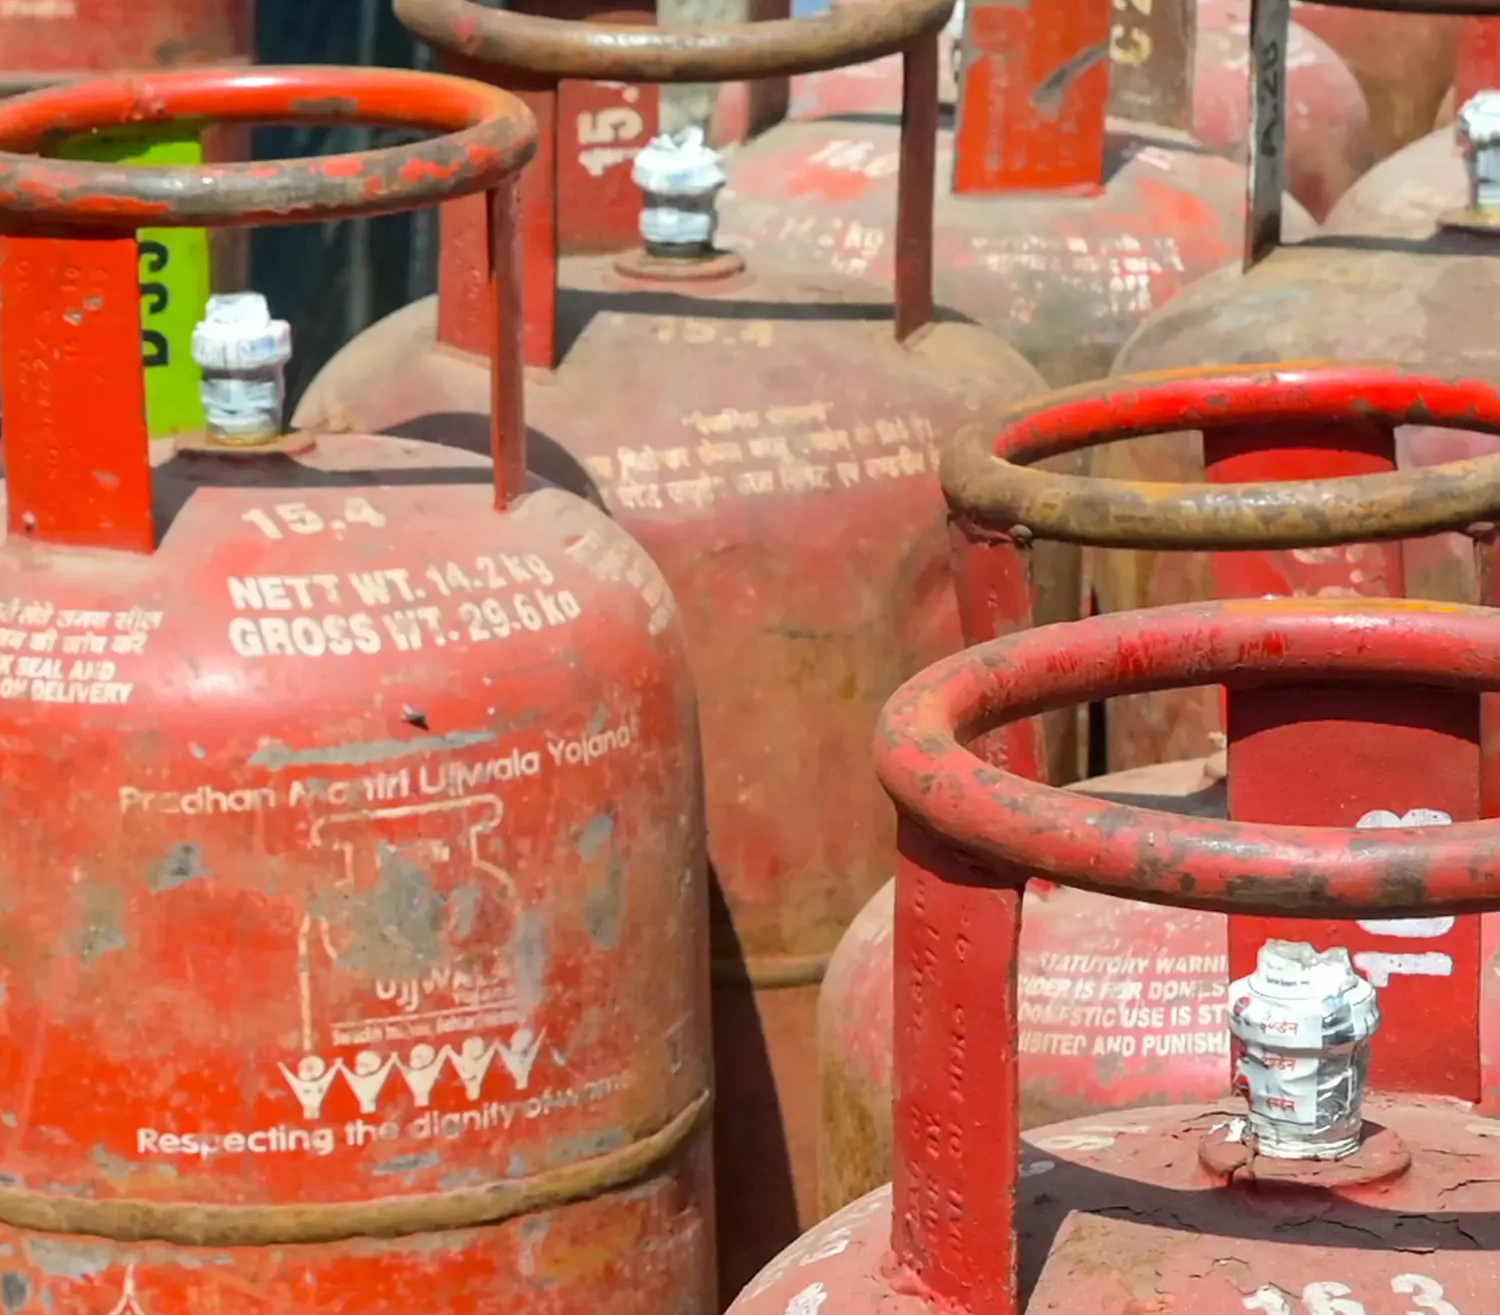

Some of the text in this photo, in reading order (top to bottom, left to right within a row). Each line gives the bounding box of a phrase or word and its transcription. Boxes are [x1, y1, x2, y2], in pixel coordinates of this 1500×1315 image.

[226, 573, 342, 611] NETT
[347, 567, 427, 607] WT.
[425, 555, 508, 597] 14.2
[228, 612, 383, 657] GROSS
[458, 591, 544, 643] 29.6
[15, 655, 63, 680] SEAL
[68, 659, 116, 682] AND
[29, 678, 135, 704] DELIVERY
[1120, 1004, 1164, 1029] USE
[1170, 1003, 1193, 1027] IS
